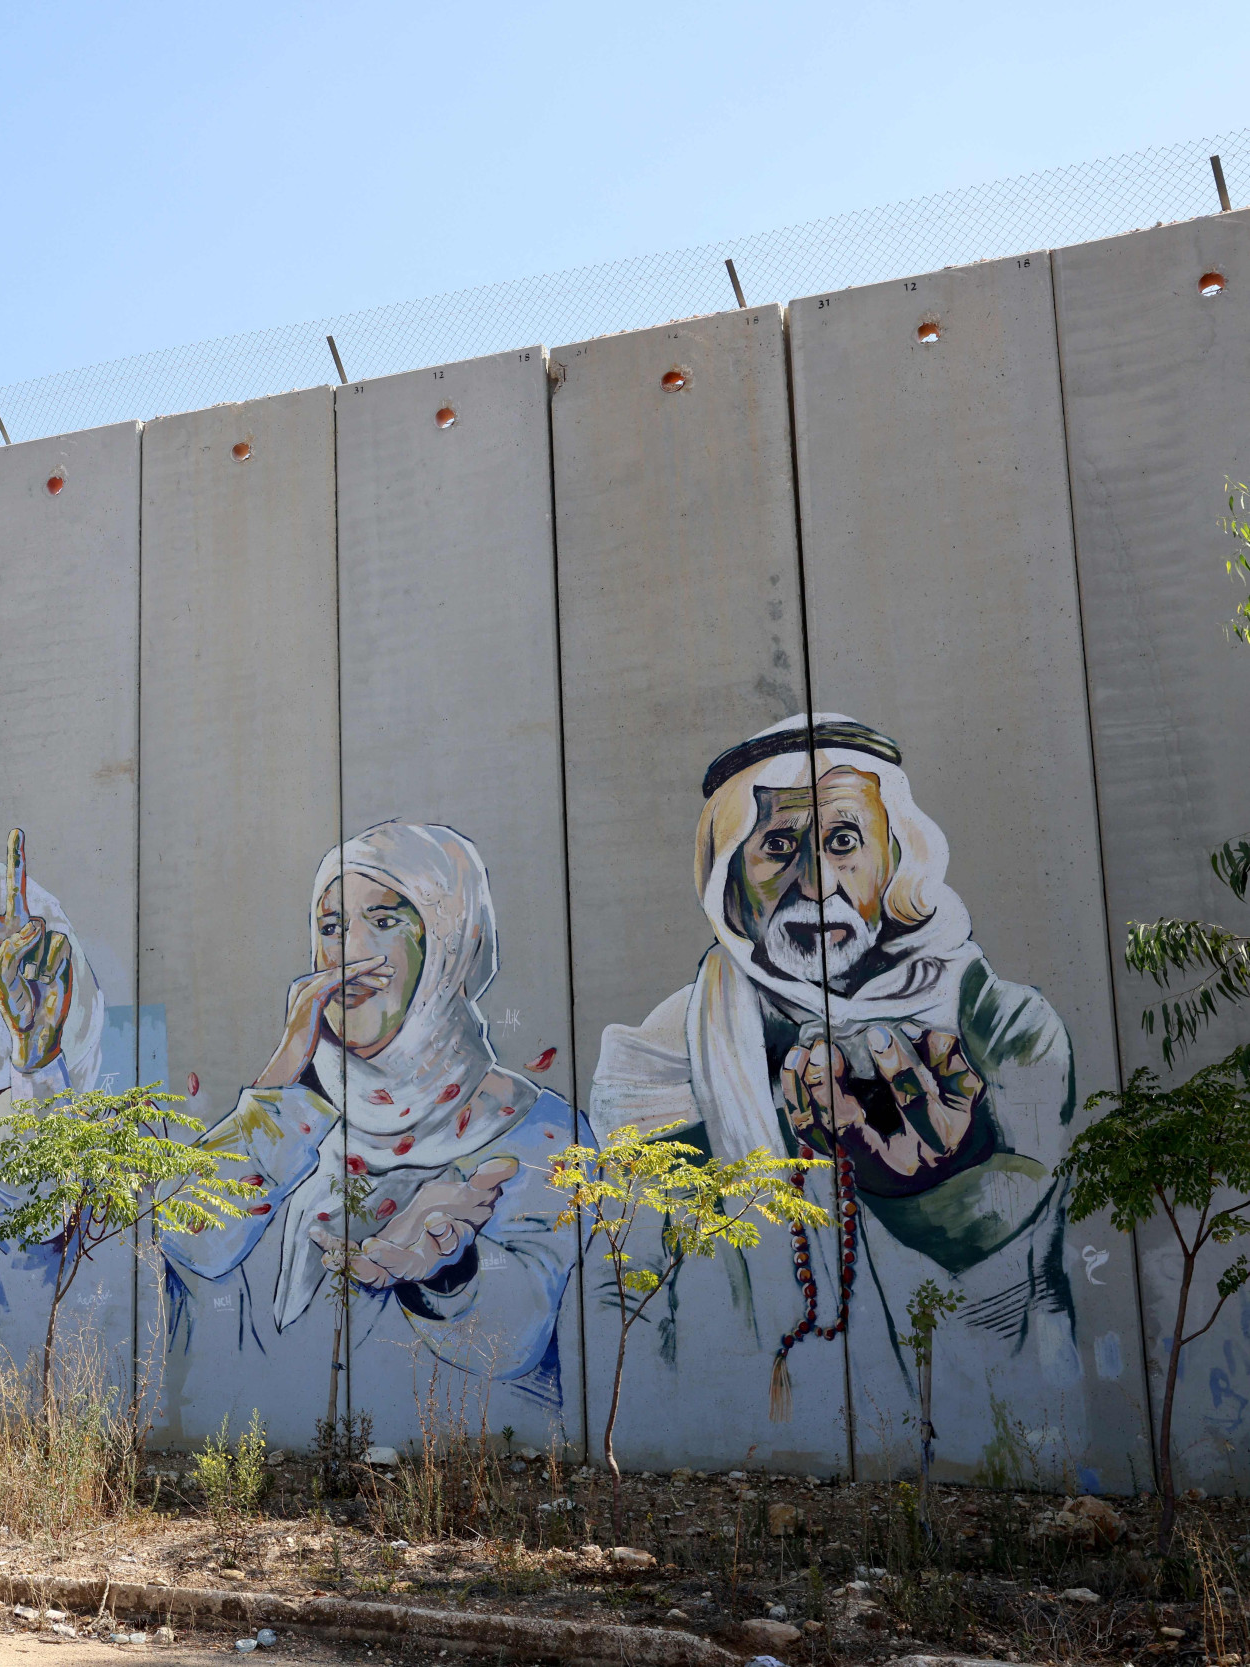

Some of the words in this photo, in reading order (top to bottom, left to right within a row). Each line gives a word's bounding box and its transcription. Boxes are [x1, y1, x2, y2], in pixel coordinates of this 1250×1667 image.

[818, 298, 830, 309] 31
[903, 282, 917, 291] 12
[1016, 258, 1031, 269] 18
[354, 386, 364, 395] 31
[432, 371, 445, 380] 12
[517, 353, 530, 363] 18
